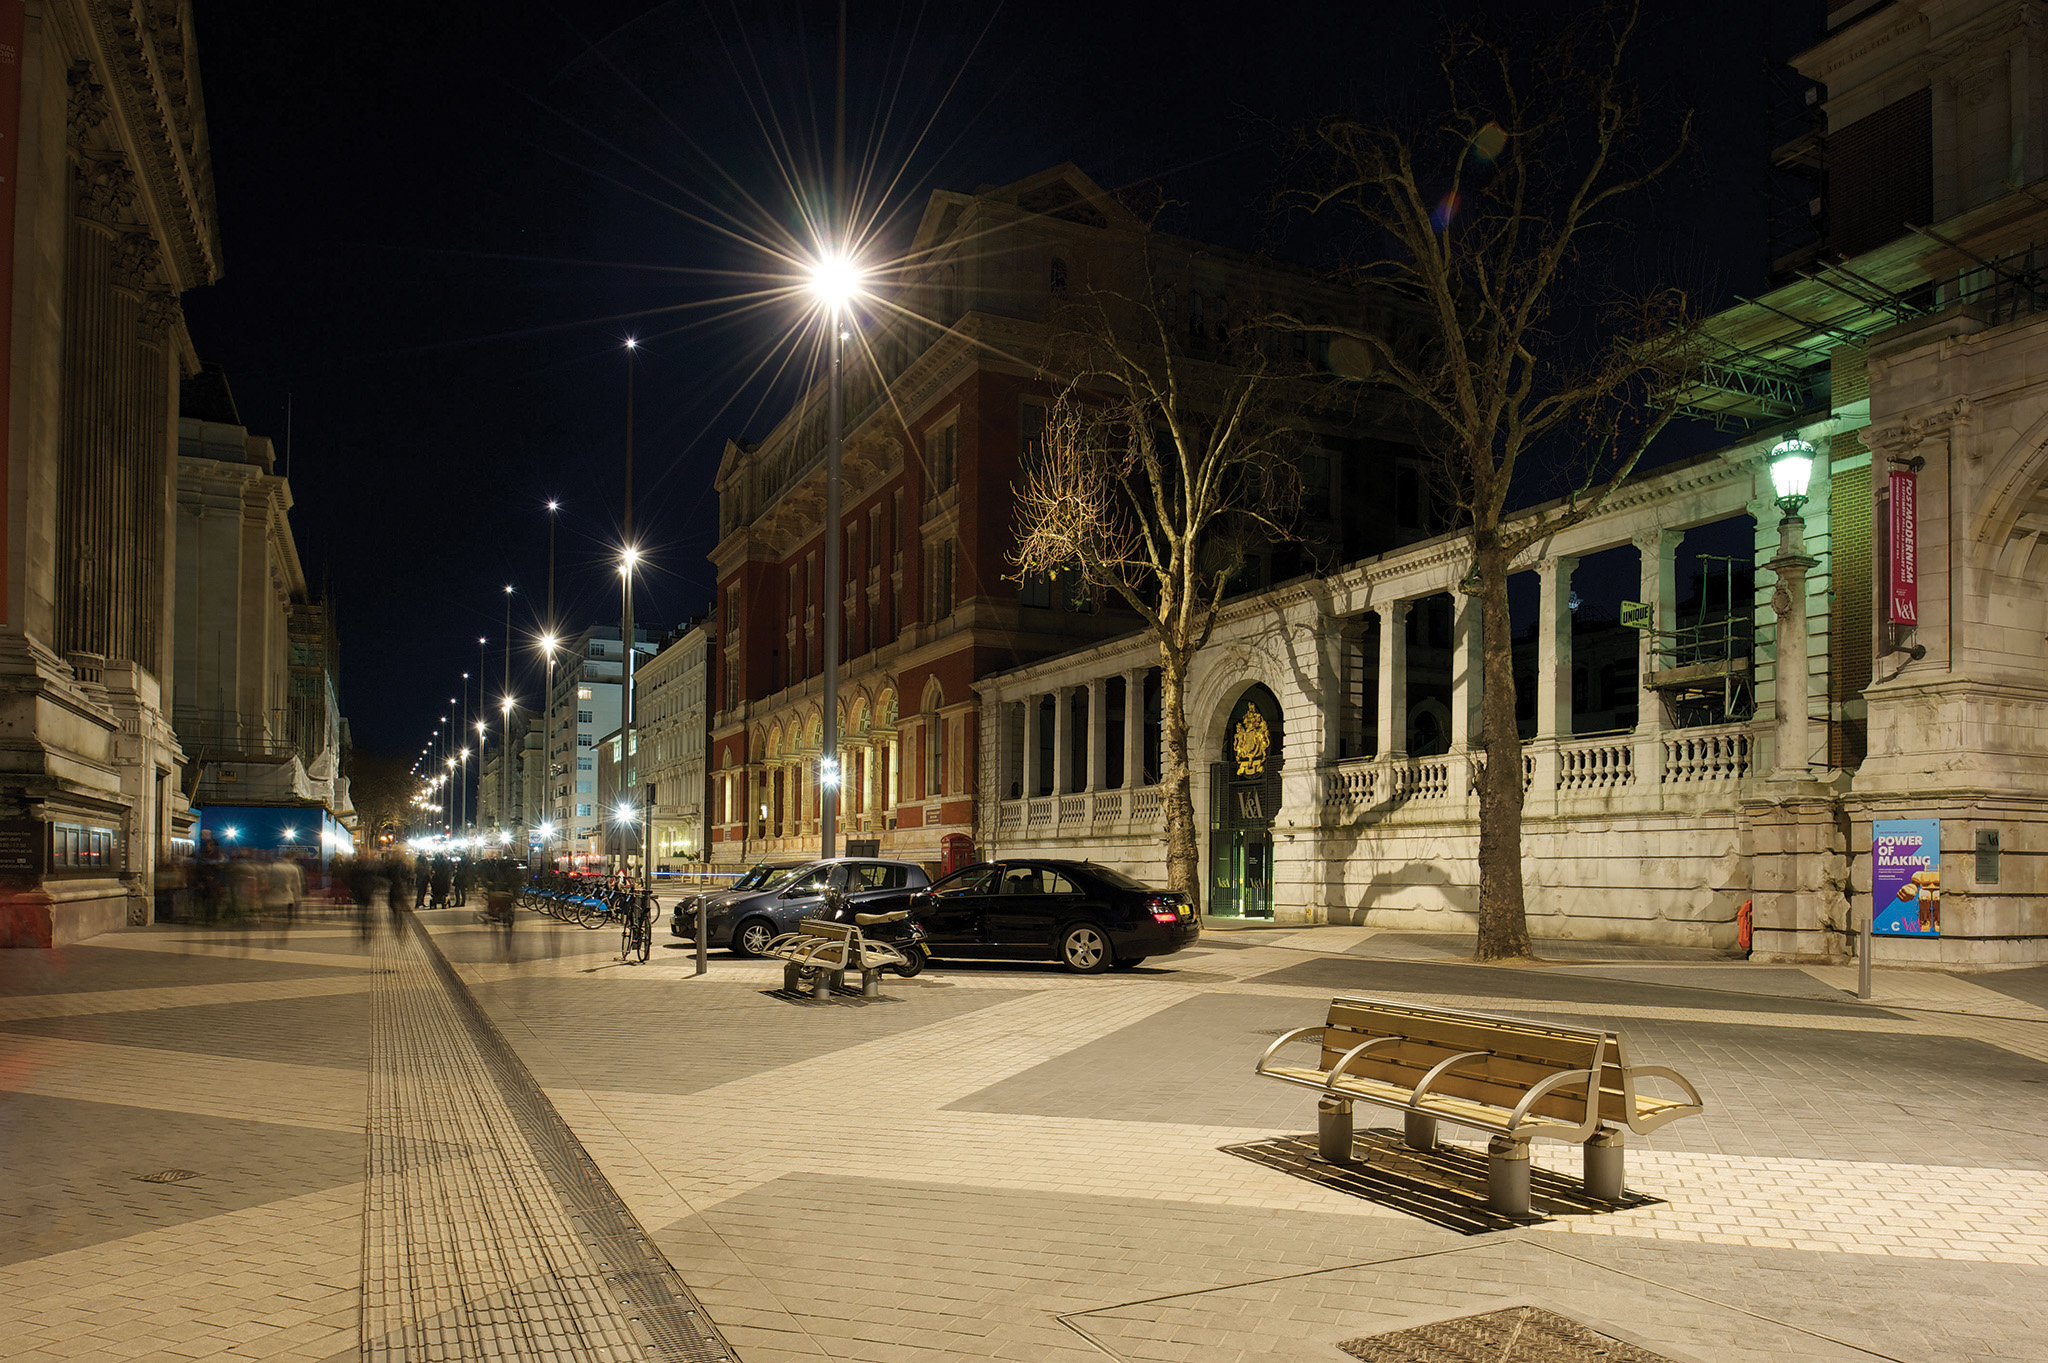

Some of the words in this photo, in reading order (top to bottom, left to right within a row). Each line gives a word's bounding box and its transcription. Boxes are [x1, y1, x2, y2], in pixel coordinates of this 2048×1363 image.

[1905, 478, 1914, 584] POSTMODERNISM
[1623, 607, 1649, 624] UNIQUE
[1895, 597, 1916, 621] V&A
[1238, 791, 1264, 819] V&A
[1878, 836, 1923, 846] POWER
[1878, 846, 1895, 856] OF
[1878, 855, 1931, 866] MAKING
